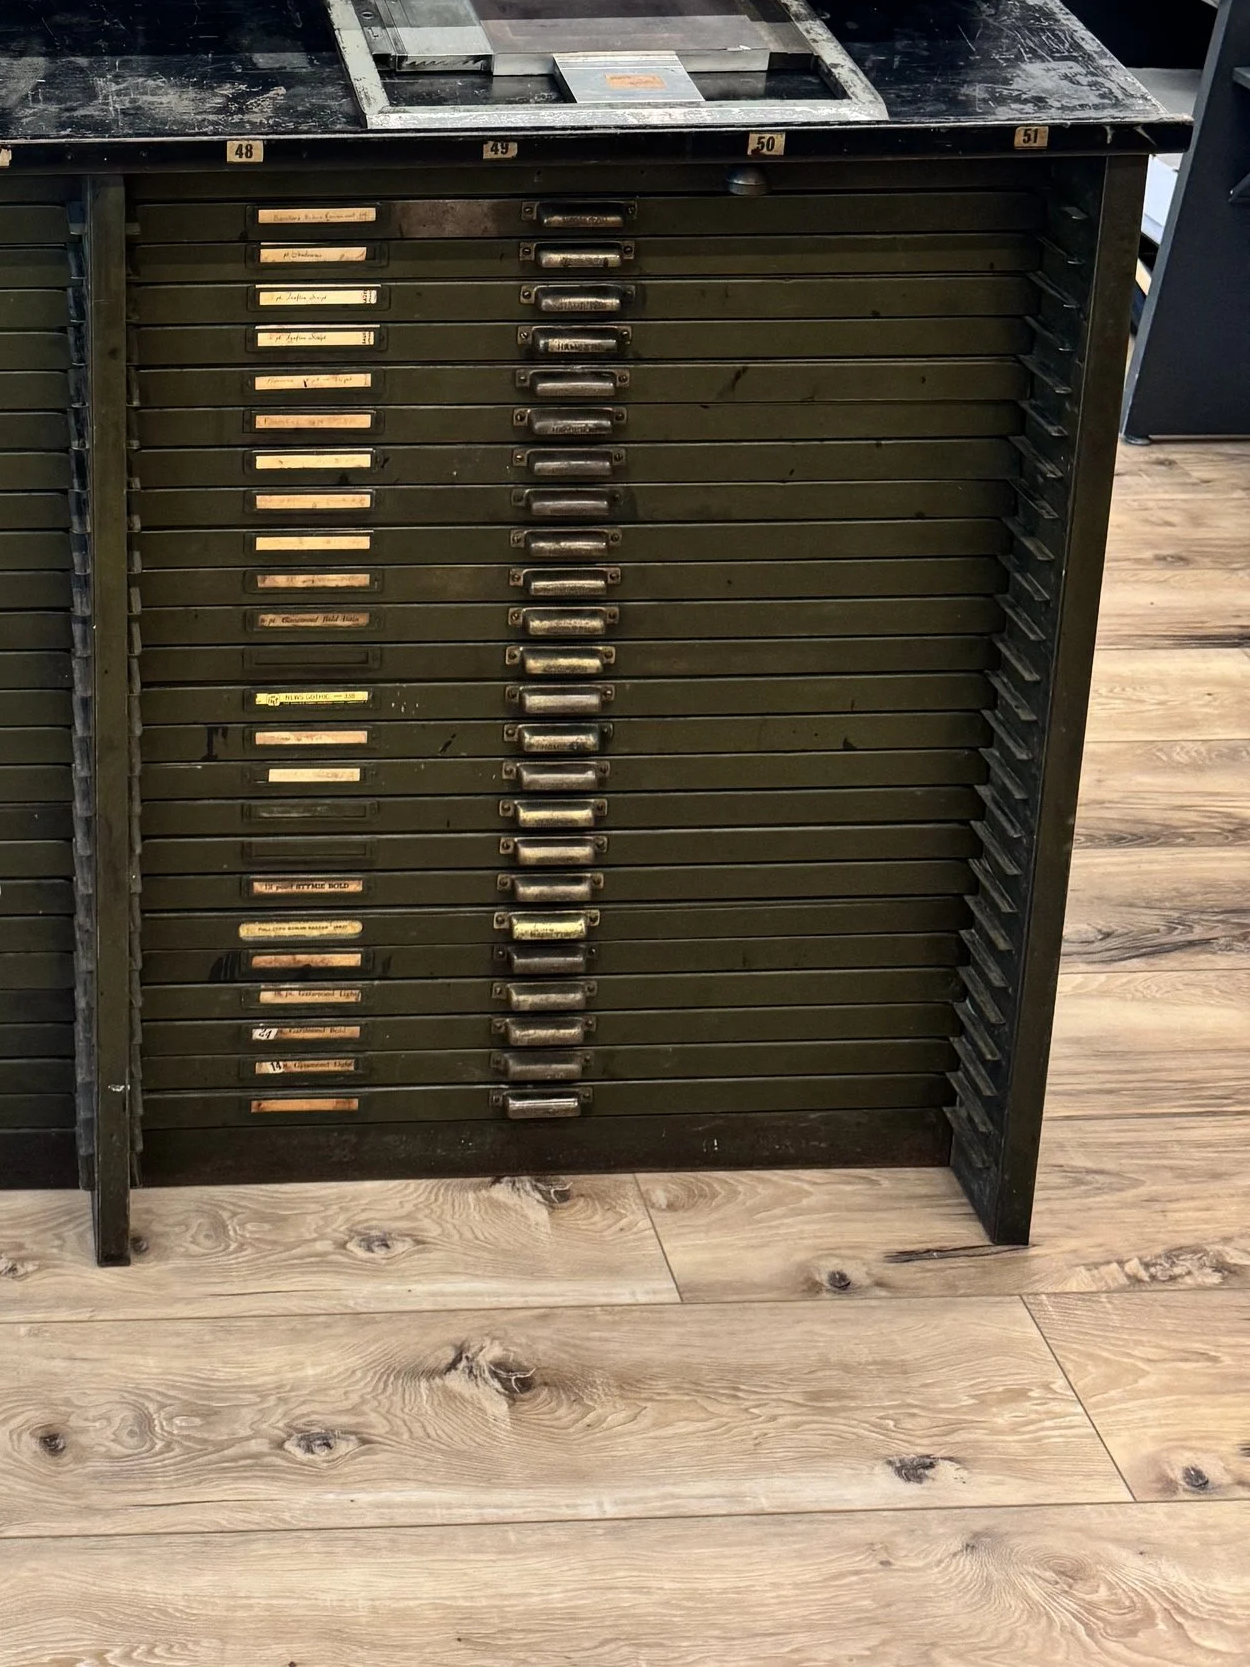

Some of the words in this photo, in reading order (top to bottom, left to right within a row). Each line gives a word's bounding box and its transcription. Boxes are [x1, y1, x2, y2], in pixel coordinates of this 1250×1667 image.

[756, 135, 776, 152] 50
[1022, 129, 1039, 144] 51
[234, 143, 253, 159] 48
[490, 141, 509, 156] 49
[295, 882, 326, 890] STYMIE
[328, 882, 350, 890] BOLD
